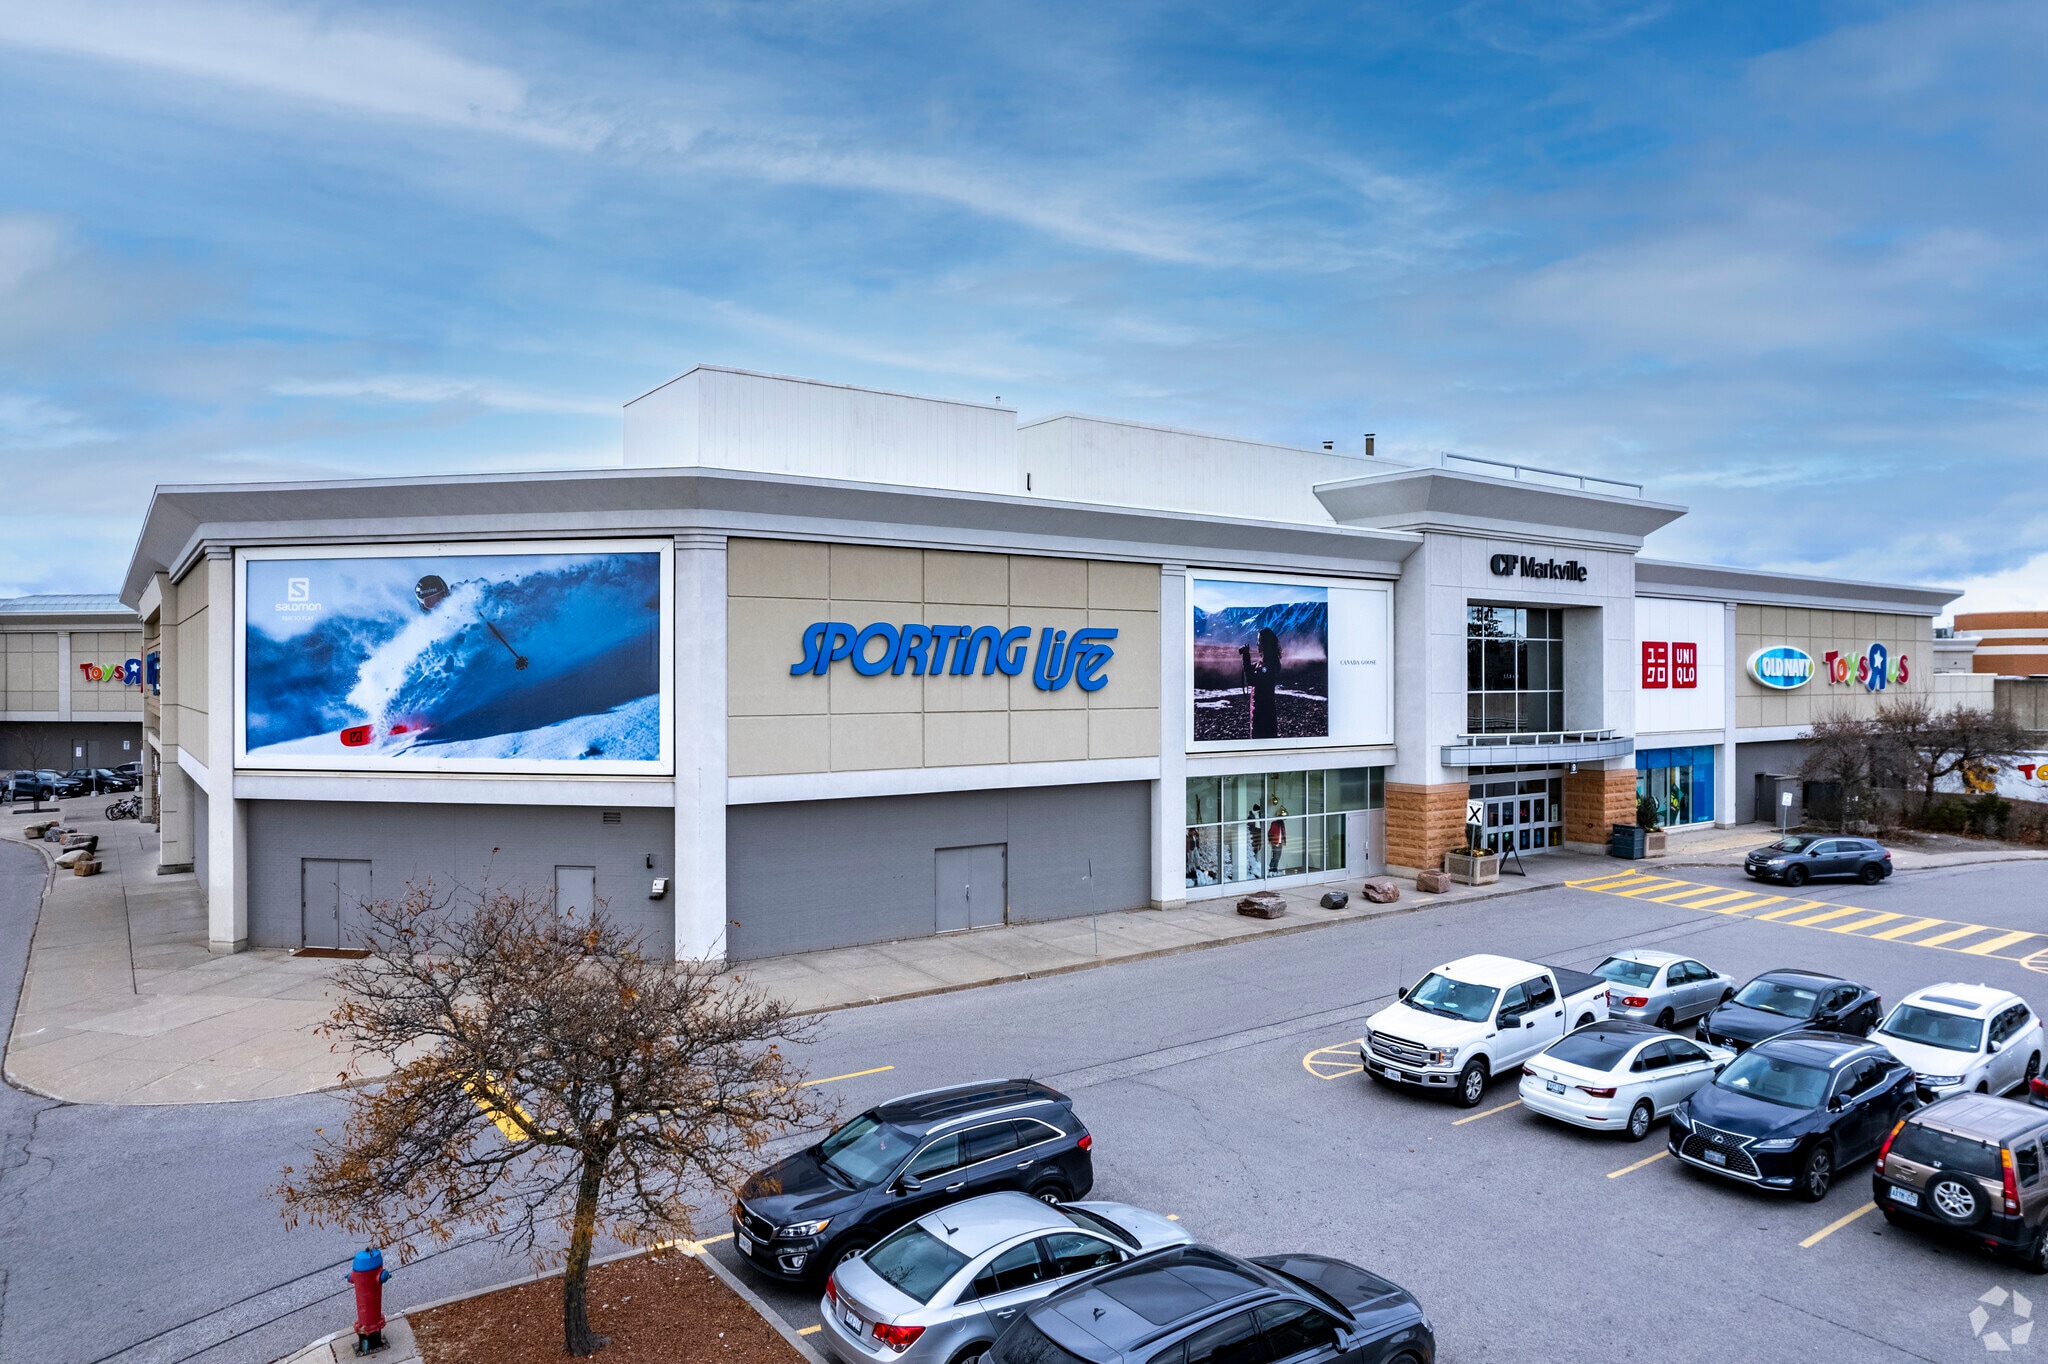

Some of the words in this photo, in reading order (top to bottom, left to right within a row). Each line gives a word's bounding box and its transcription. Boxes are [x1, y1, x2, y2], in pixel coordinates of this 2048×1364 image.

[1490, 554, 1519, 576] CF
[1520, 556, 1588, 582] Markville
[1676, 648, 1694, 664] UNI
[1676, 667, 1695, 685] QLO
[1762, 656, 1783, 677] OLD
[1784, 658, 1811, 678] NAVY
